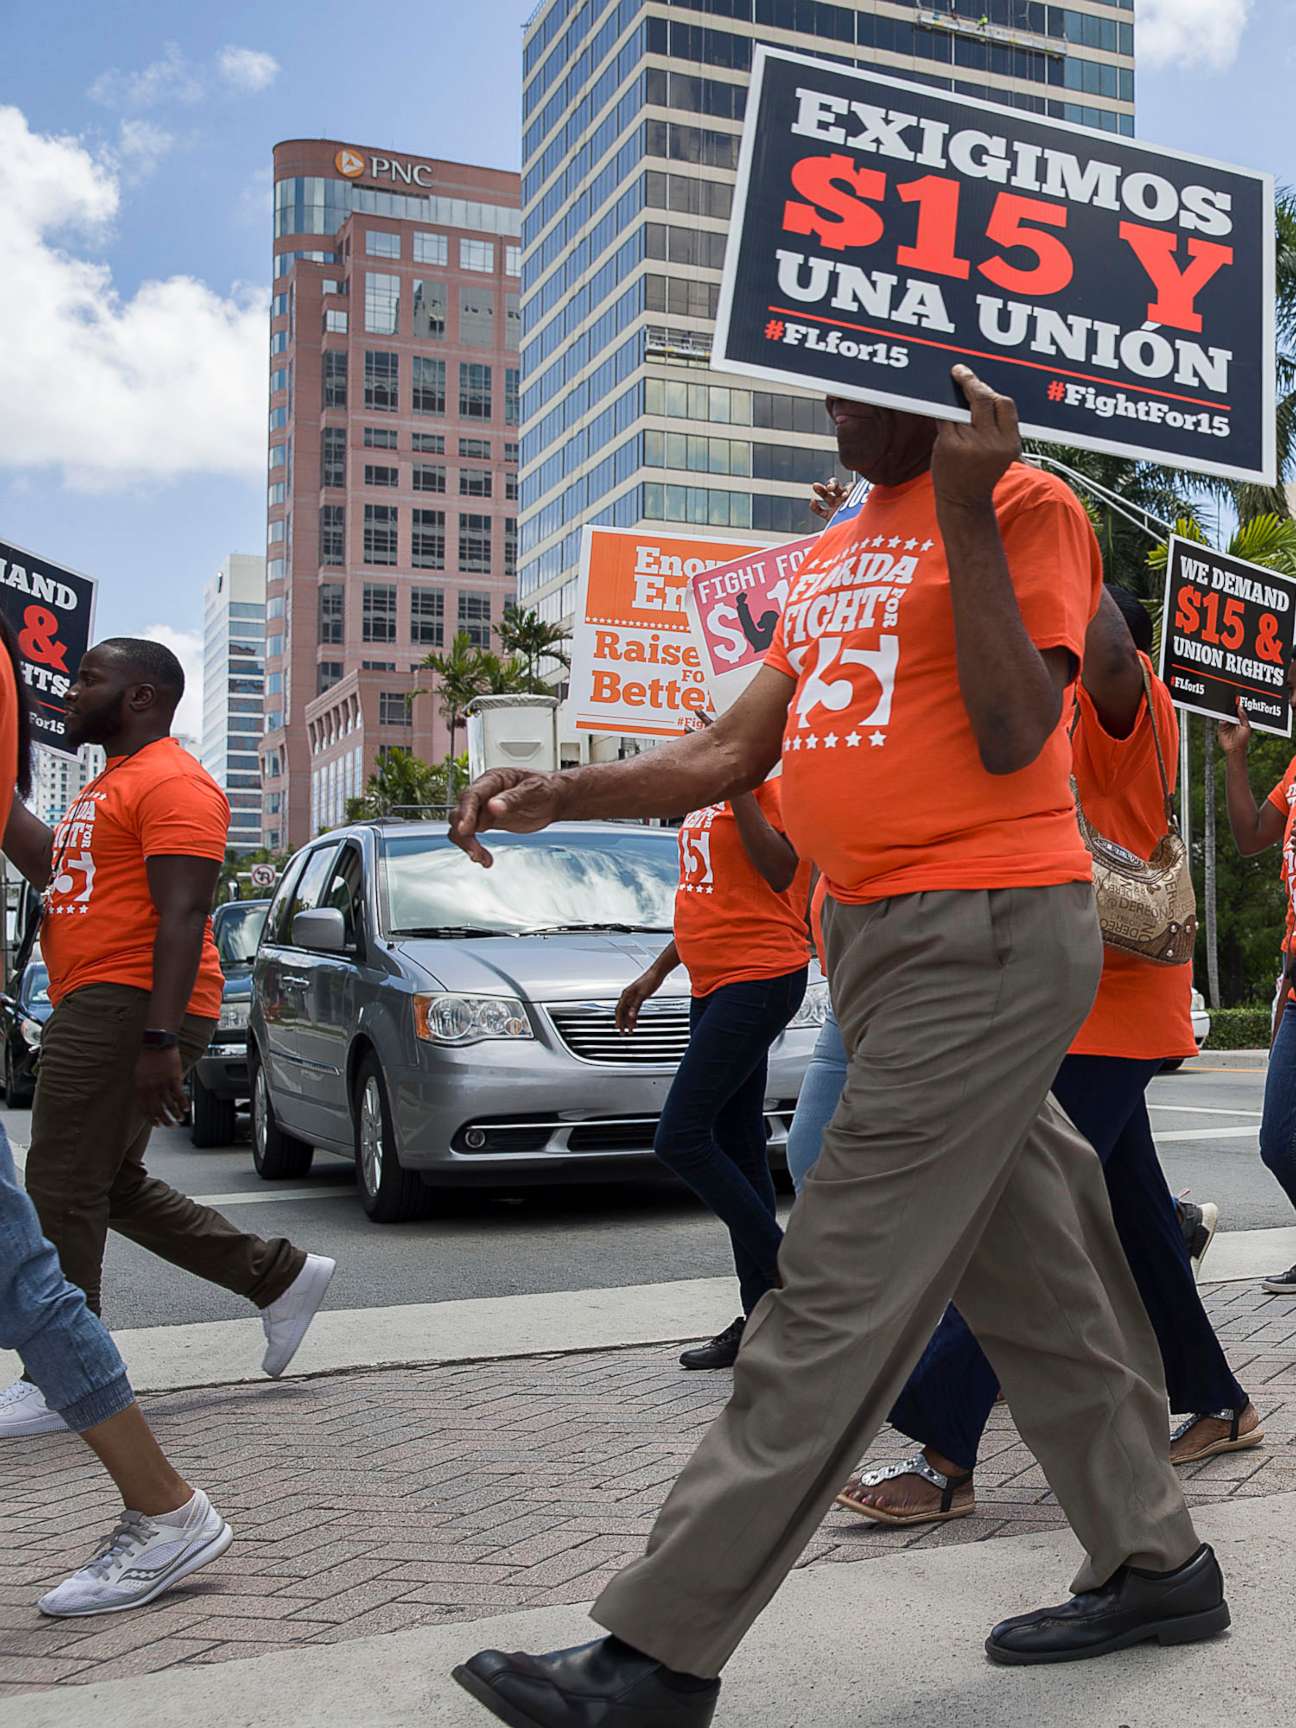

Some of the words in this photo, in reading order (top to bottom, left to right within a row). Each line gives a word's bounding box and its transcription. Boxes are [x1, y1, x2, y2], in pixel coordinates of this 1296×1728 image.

[369, 156, 433, 188] PNC
[791, 88, 1233, 237] EXIGIMOS
[782, 153, 1074, 296] $15
[1118, 220, 1234, 333] Y
[764, 319, 909, 369] #FLfor15
[775, 249, 955, 334] UNA
[976, 293, 1233, 394] UNIÓN
[1047, 381, 1231, 438] #FightFor15
[698, 562, 766, 604] FIGHT
[1180, 555, 1209, 586] WE
[1211, 567, 1290, 612] DEMAND
[18, 604, 70, 673] &
[783, 586, 894, 648] FIGHT
[882, 588, 905, 628] FOR
[1175, 584, 1245, 650] $15
[1255, 613, 1284, 665] &
[593, 630, 701, 667] Raise
[1173, 636, 1224, 668] UNION
[1225, 655, 1285, 687] RIGHTS
[1170, 675, 1205, 695] #FLfor15
[1235, 695, 1282, 717] #FightFor15
